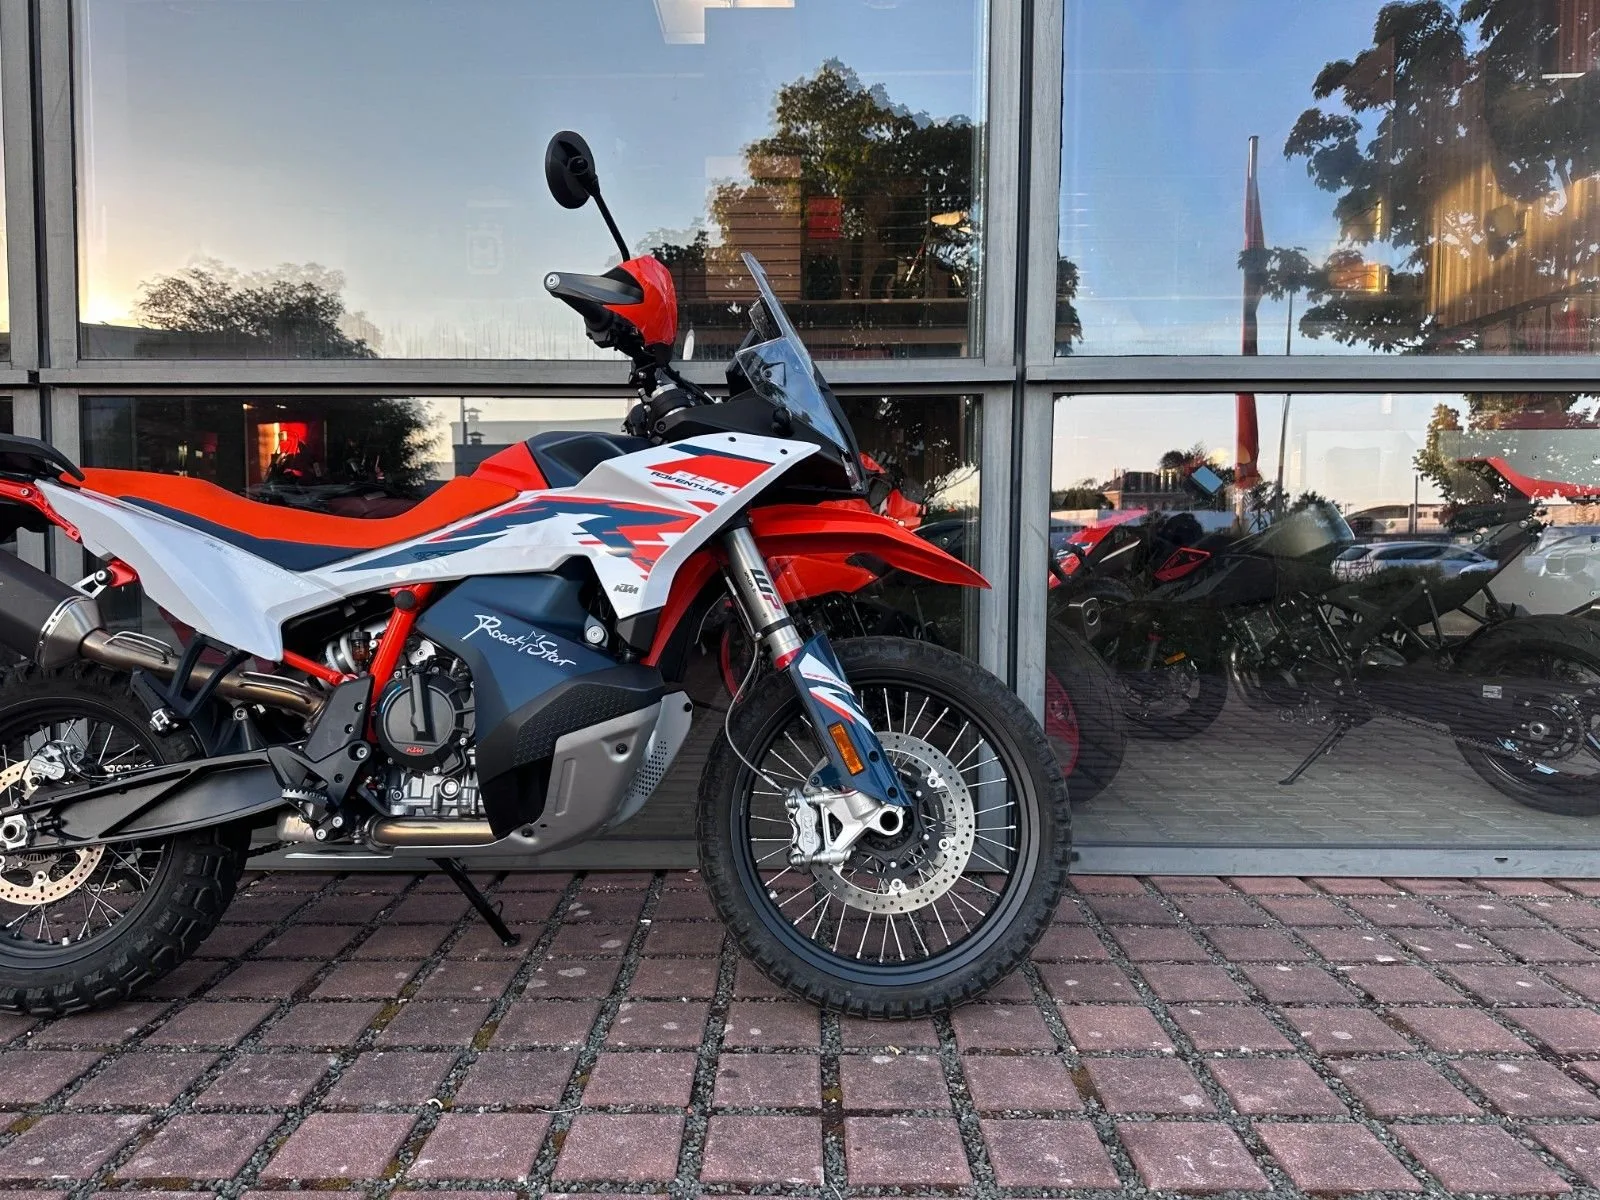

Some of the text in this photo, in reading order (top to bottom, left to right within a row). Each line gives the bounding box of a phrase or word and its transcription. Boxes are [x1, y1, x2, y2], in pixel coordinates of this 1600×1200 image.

[650, 471, 726, 496] ADVENTURE
[613, 583, 639, 594] KTM
[750, 568, 782, 610] WP
[460, 614, 577, 666] Road Star
